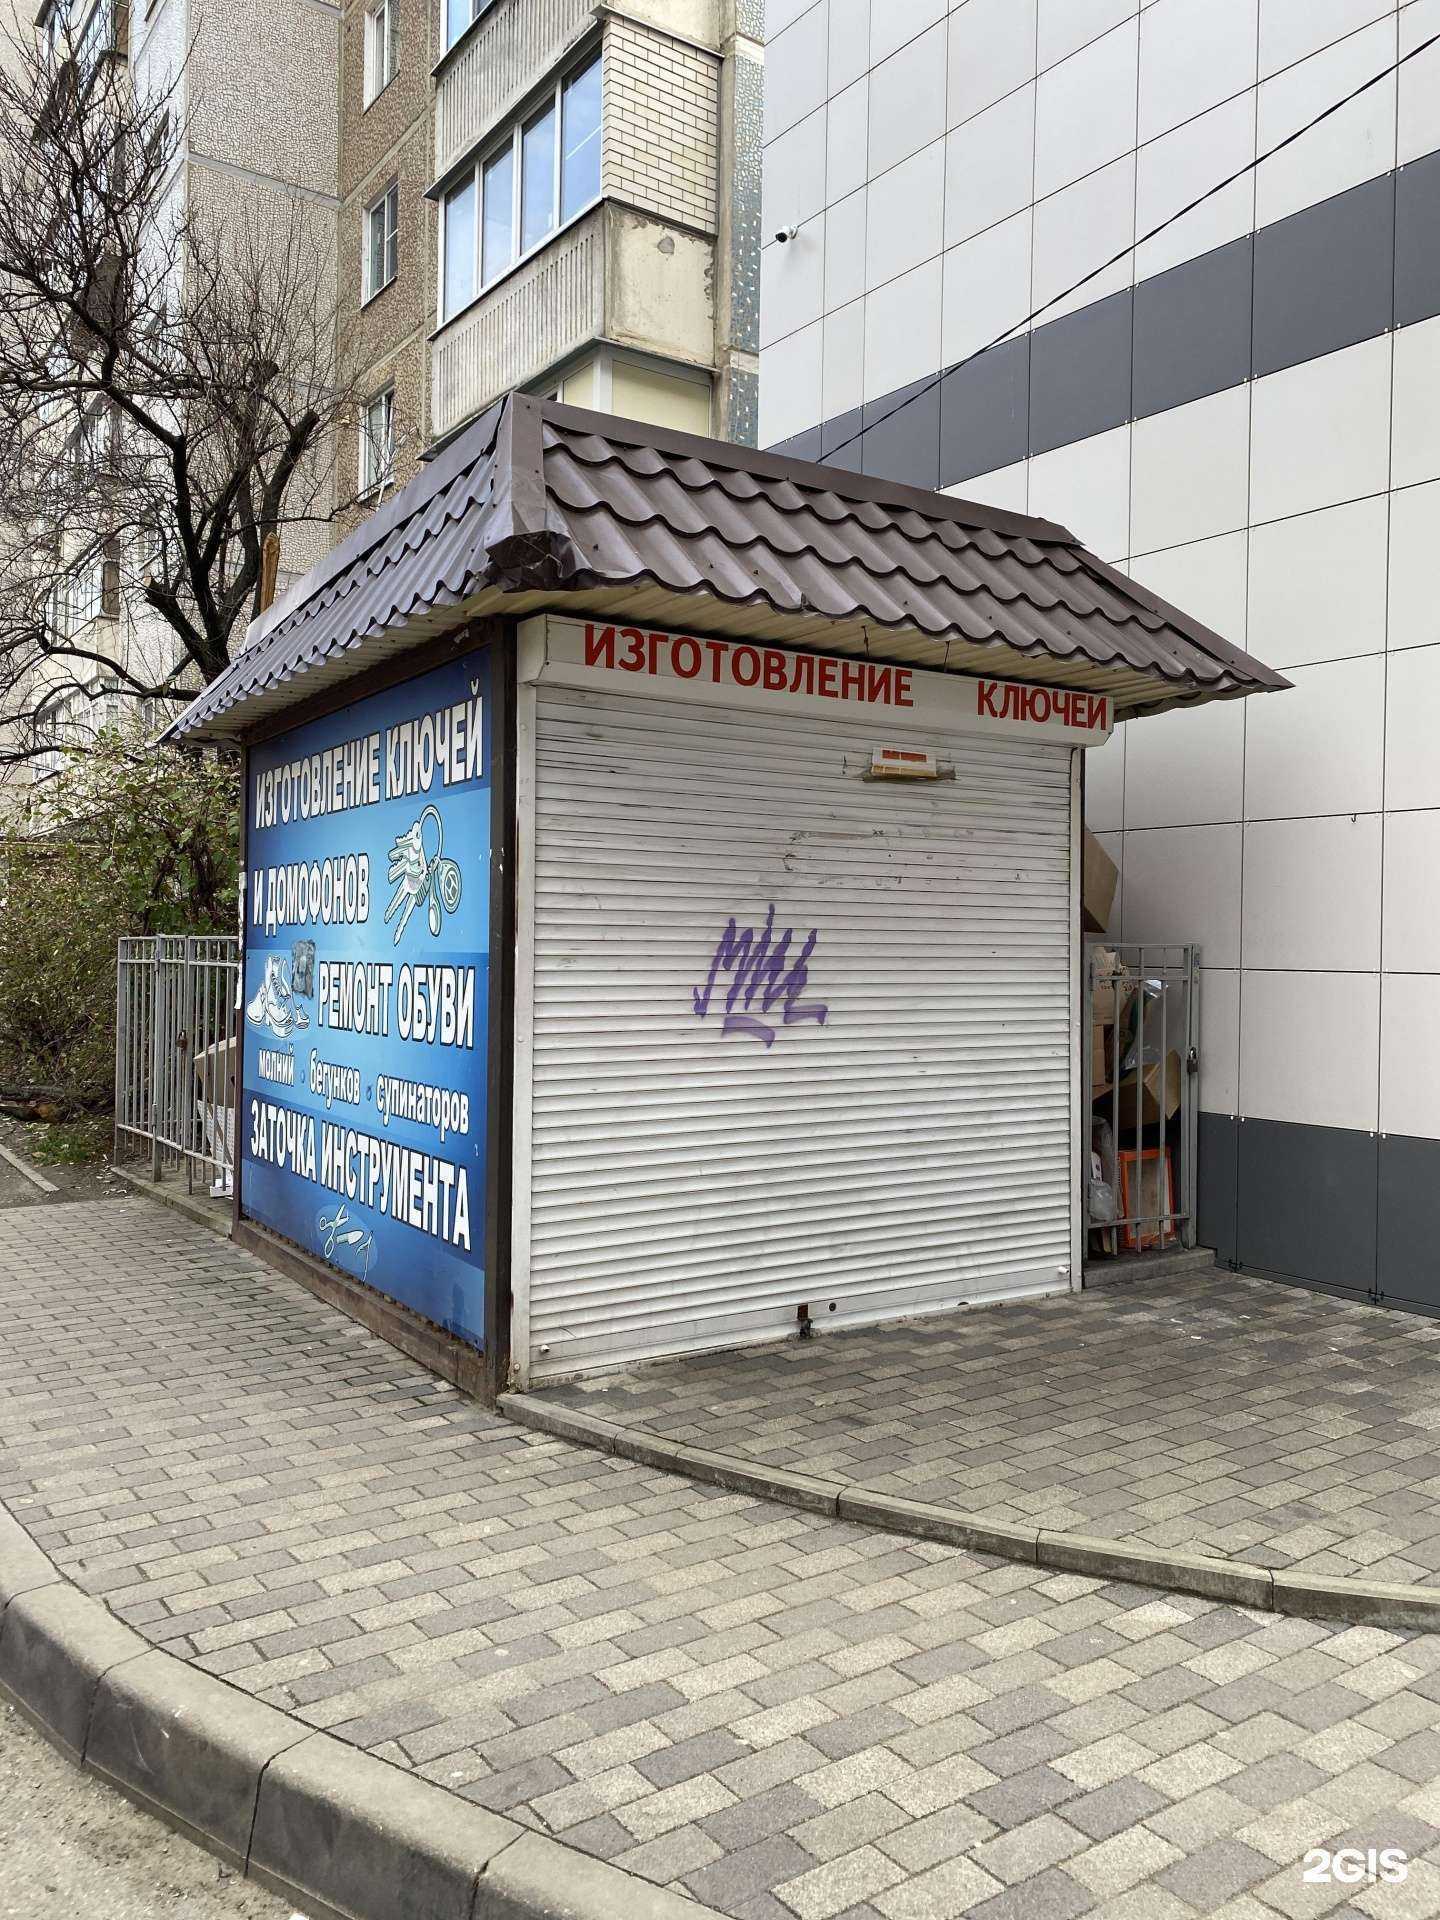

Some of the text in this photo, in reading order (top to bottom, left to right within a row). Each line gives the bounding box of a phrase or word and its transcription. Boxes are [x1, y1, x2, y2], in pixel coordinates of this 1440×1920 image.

[584, 622, 914, 707] ИЗГОТОВЛЕНИЕ
[256, 677, 483, 829] ИЗГОТОВЛЕНИЕ КЛЮЧЕЙ
[253, 852, 370, 937] И ДОМОФОНОВ
[318, 961, 476, 1050] РЕМОНТ ОБУВИ
[310, 1048, 361, 1109] бегунков
[376, 1074, 470, 1144] супинаторов
[250, 1099, 472, 1251] ЗАТОЧКА ИНСТРУМЕНТА
